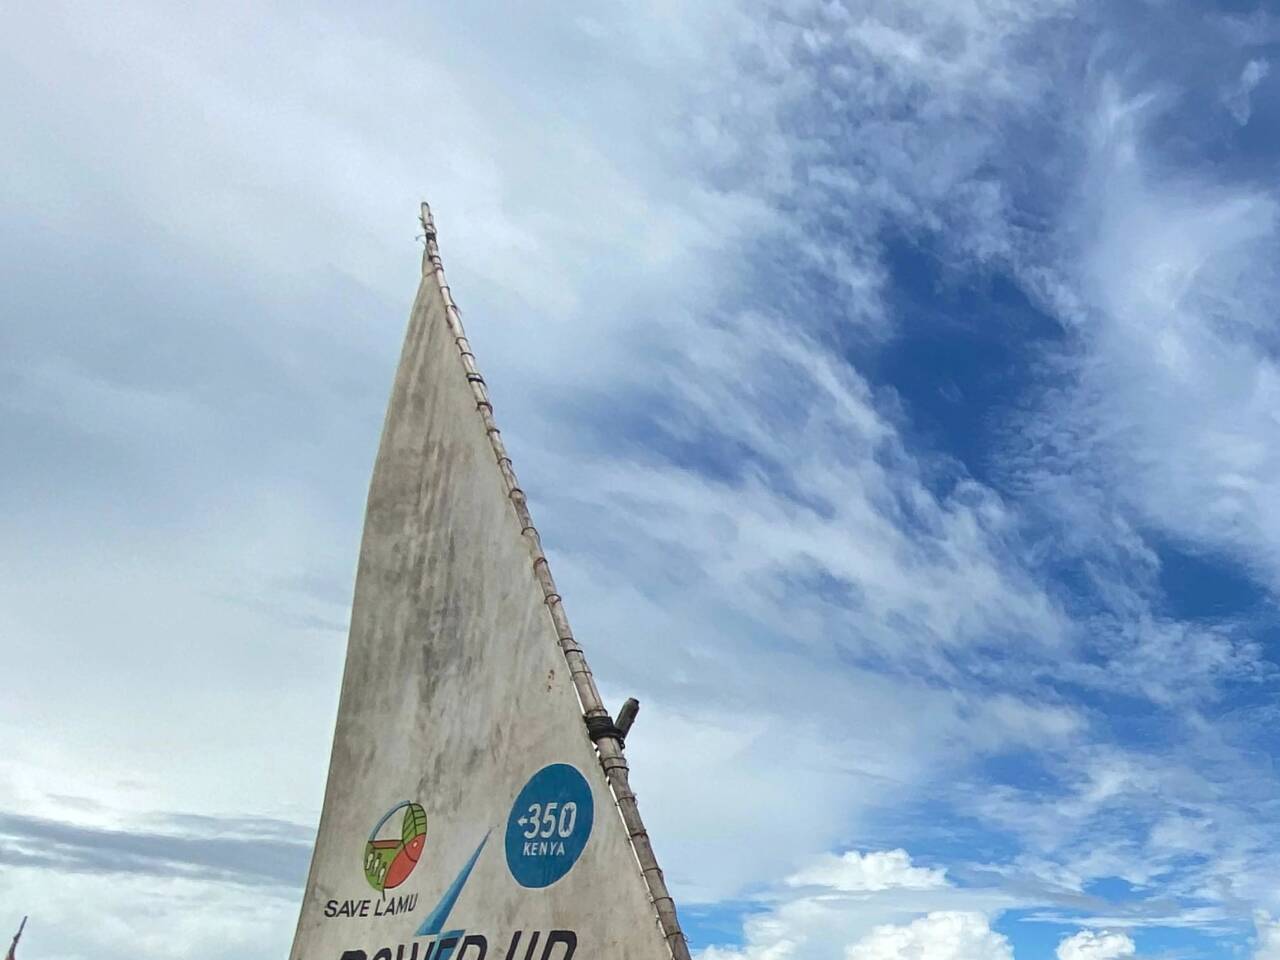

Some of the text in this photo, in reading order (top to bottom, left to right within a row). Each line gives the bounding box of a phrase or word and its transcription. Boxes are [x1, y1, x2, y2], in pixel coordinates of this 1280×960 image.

[523, 802, 577, 839] 350
[523, 841, 566, 857] KENYA
[323, 893, 419, 918] SAVE LAMU
